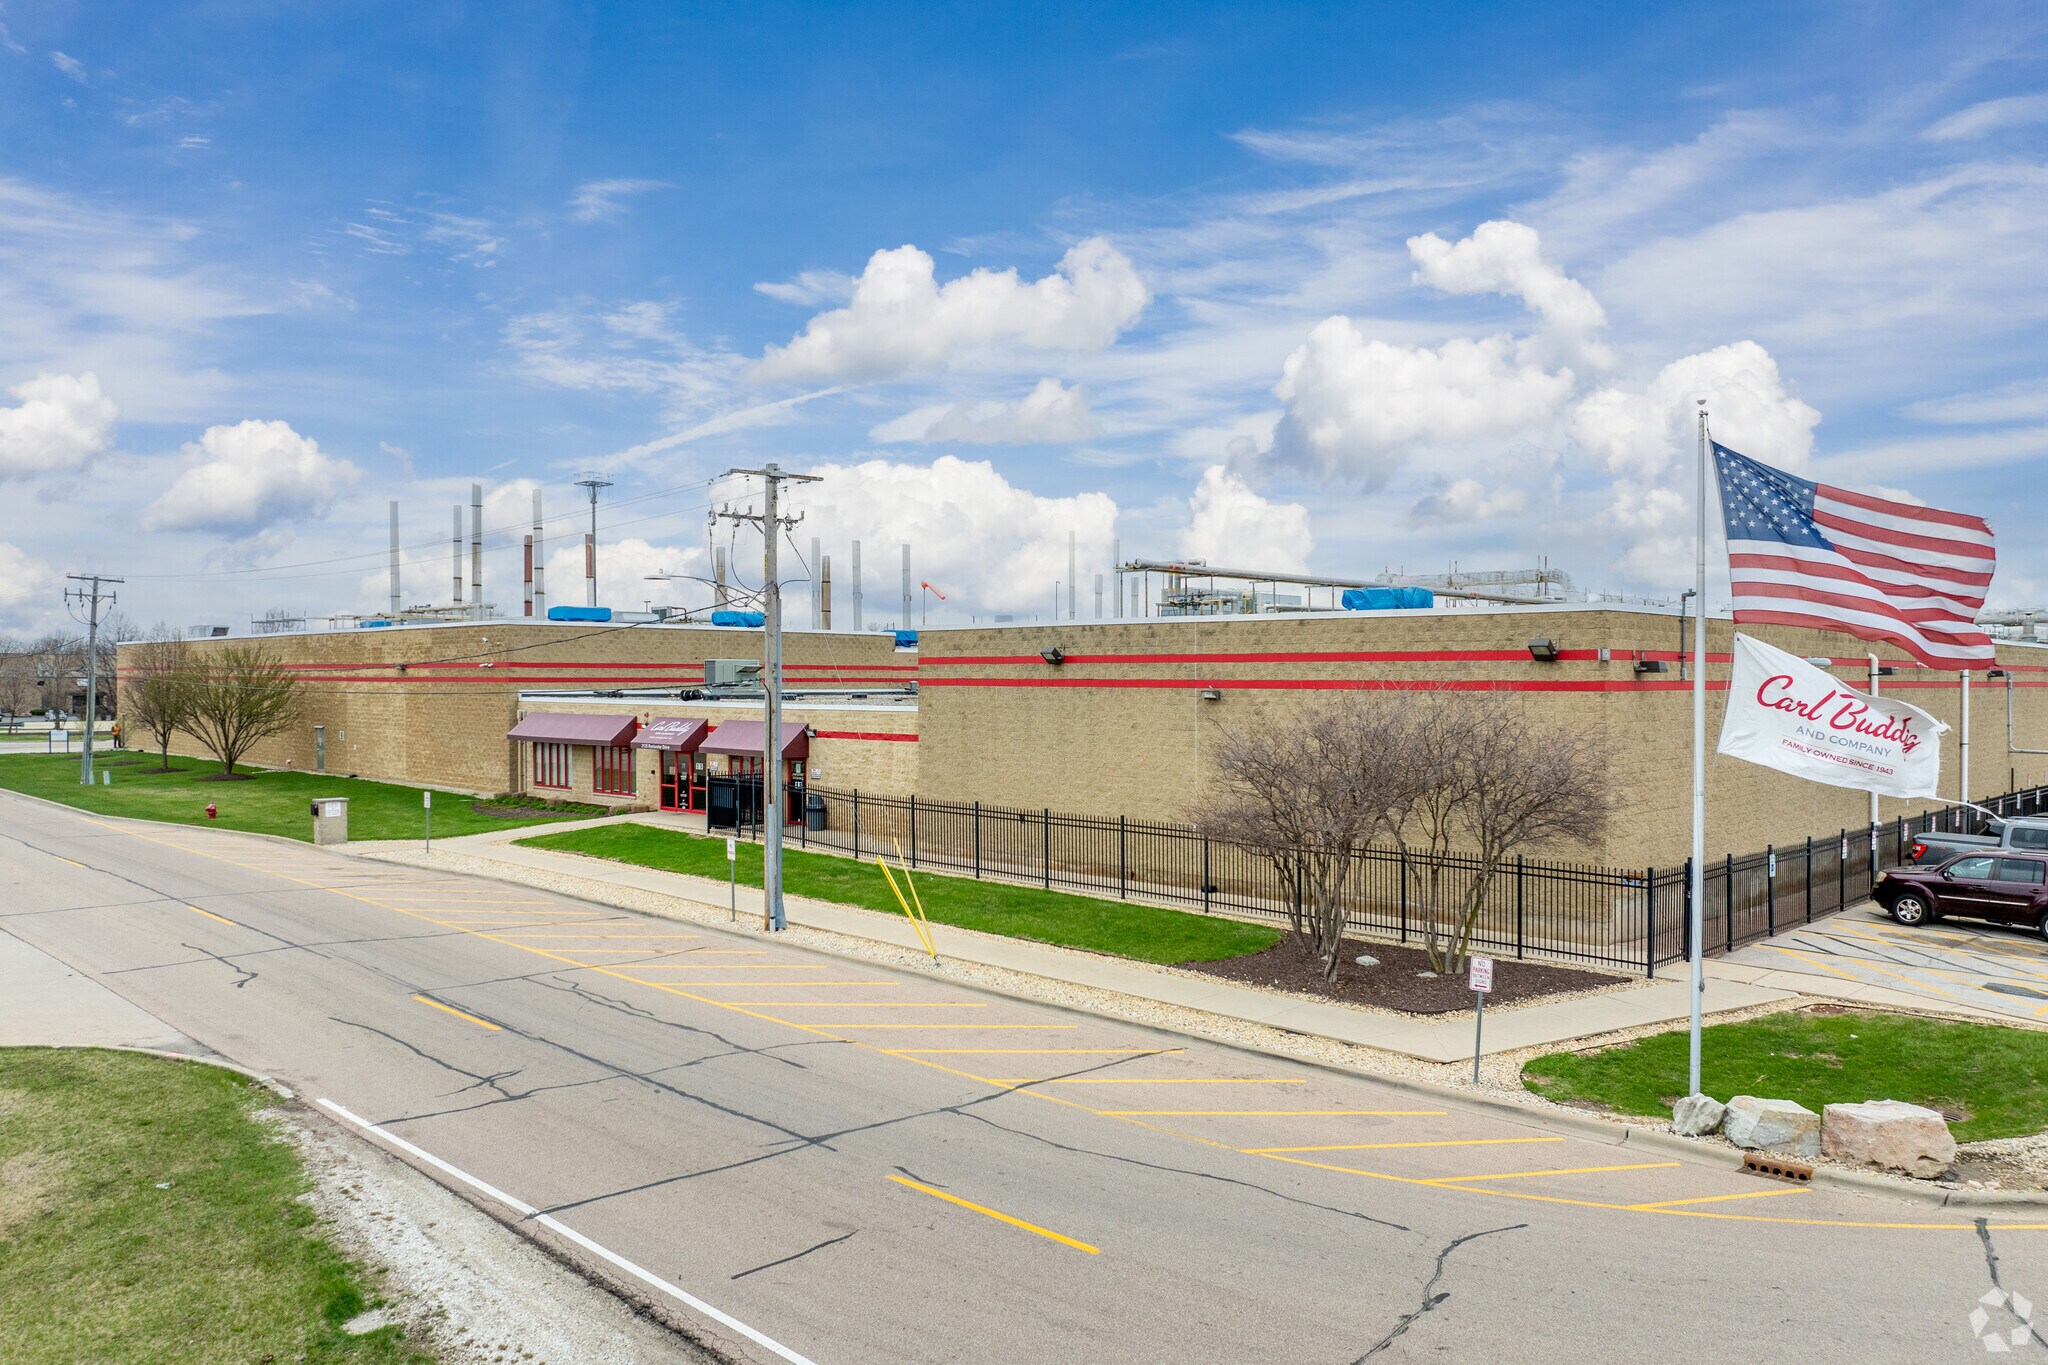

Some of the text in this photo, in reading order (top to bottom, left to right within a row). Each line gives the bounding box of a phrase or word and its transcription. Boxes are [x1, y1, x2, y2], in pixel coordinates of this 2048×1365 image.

[1756, 674, 1837, 721] Carl
[1782, 738, 1894, 776] FAMILY OWNED SINCE 1943
[1796, 725, 1892, 757] AND COMPANY
[1473, 967, 1490, 975] PARKING
